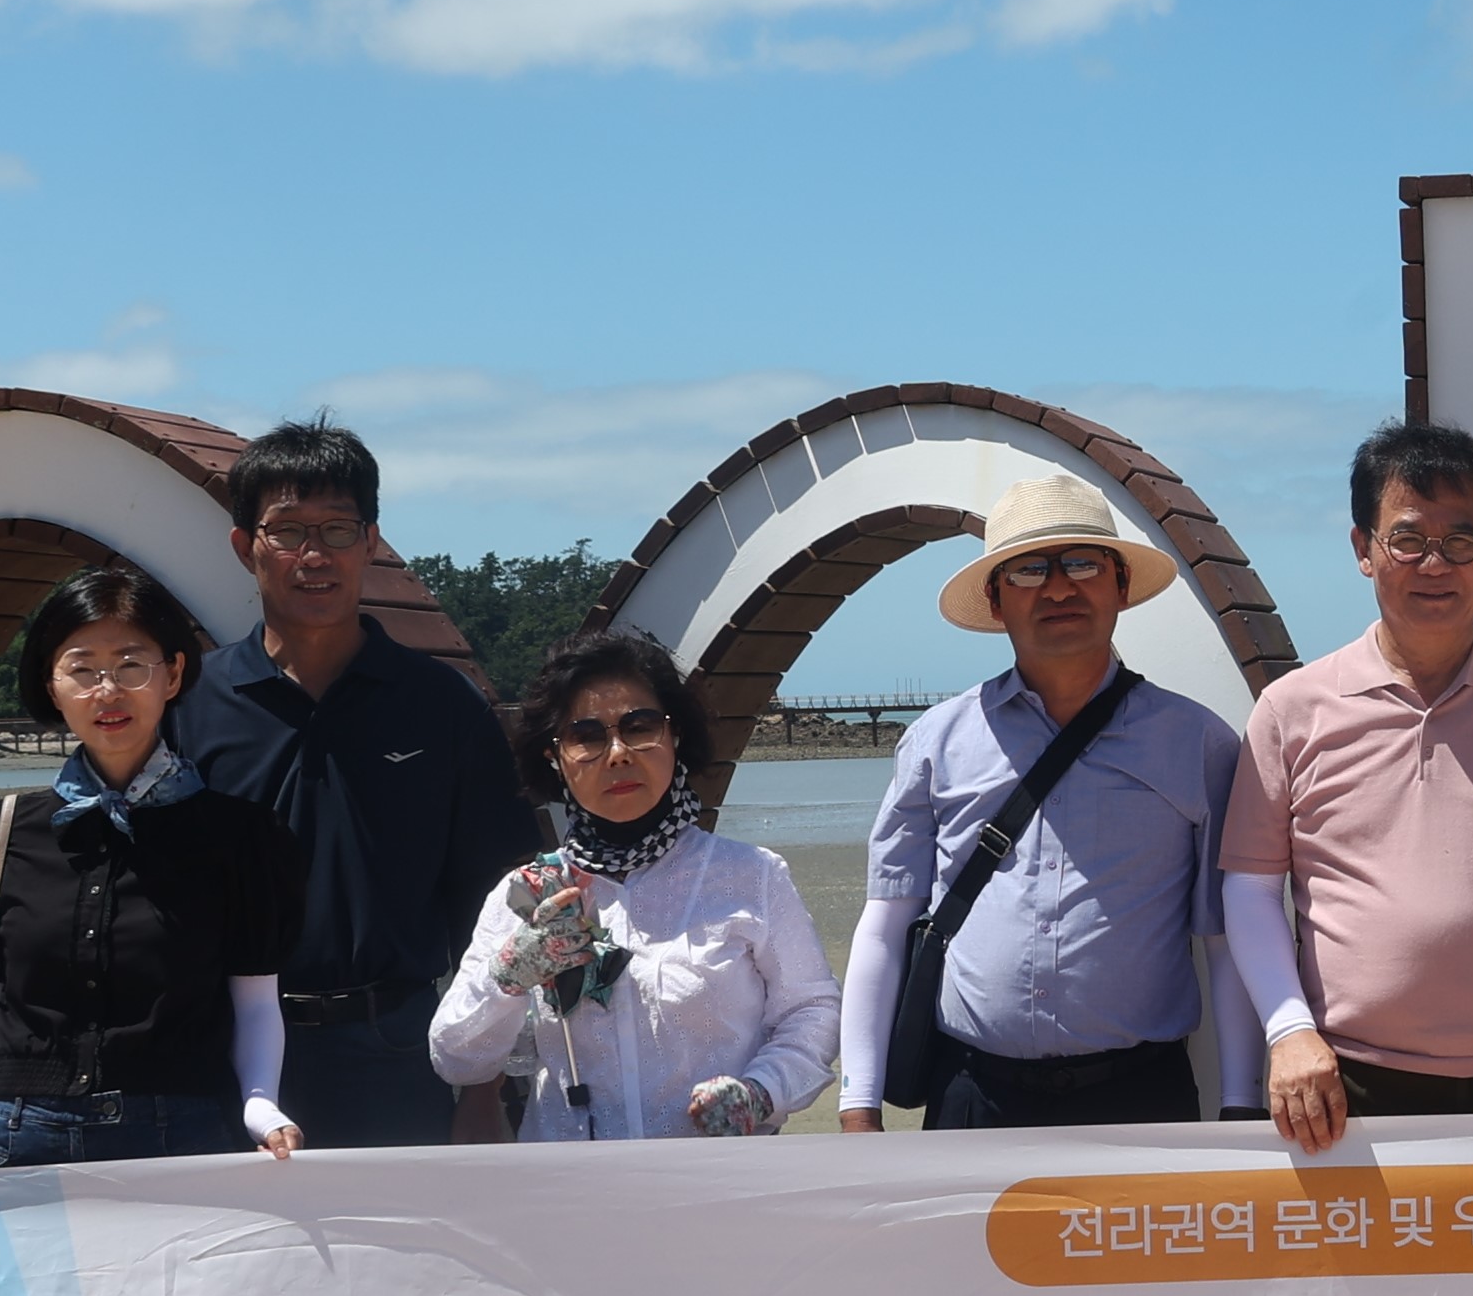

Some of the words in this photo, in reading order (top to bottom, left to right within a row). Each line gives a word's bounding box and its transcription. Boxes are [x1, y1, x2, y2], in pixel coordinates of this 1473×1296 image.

[1058, 1205, 1254, 1258] 전라권역
[1273, 1196, 1374, 1251] 문화
[1389, 1195, 1434, 1248] 및
